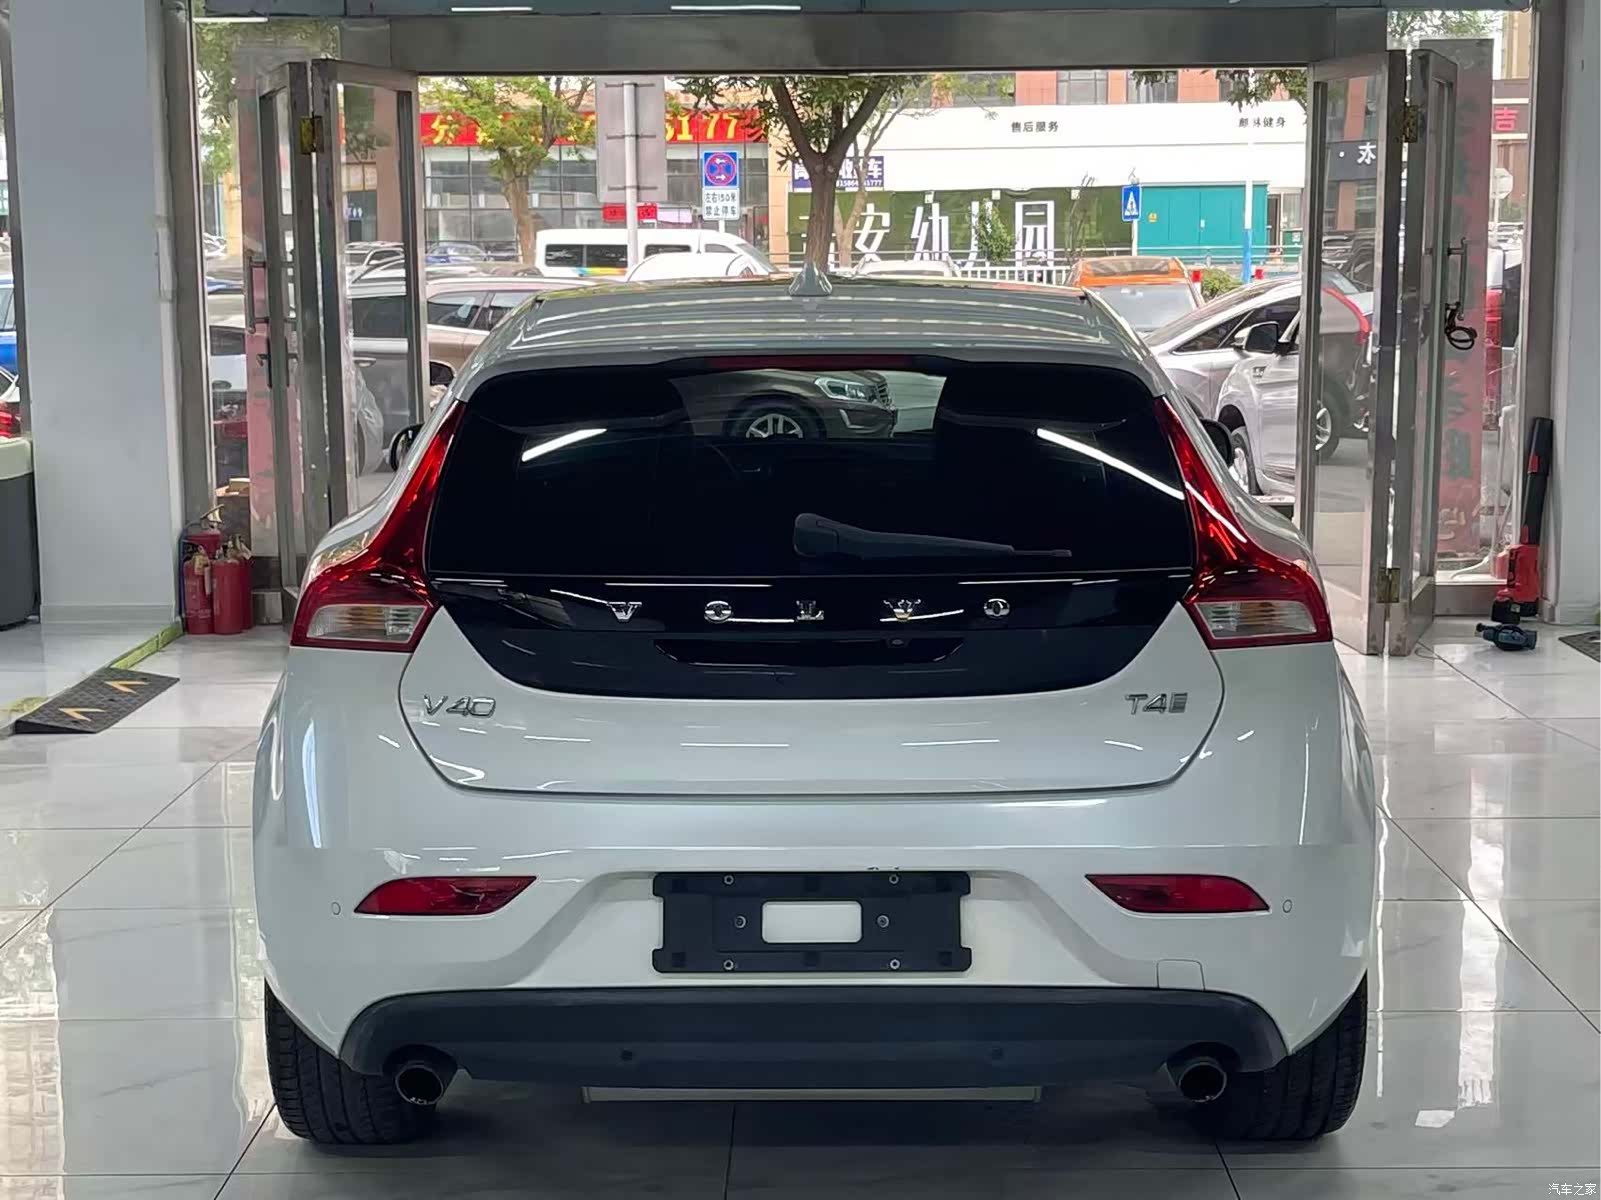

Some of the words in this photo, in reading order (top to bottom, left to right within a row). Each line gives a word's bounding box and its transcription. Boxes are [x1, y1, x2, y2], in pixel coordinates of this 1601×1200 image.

[1011, 121, 1059, 133] 售后服务
[705, 192, 737, 203] 左右150米
[705, 205, 737, 217] 禁止停车
[606, 598, 1010, 622] VOLVO
[423, 694, 496, 718] V40
